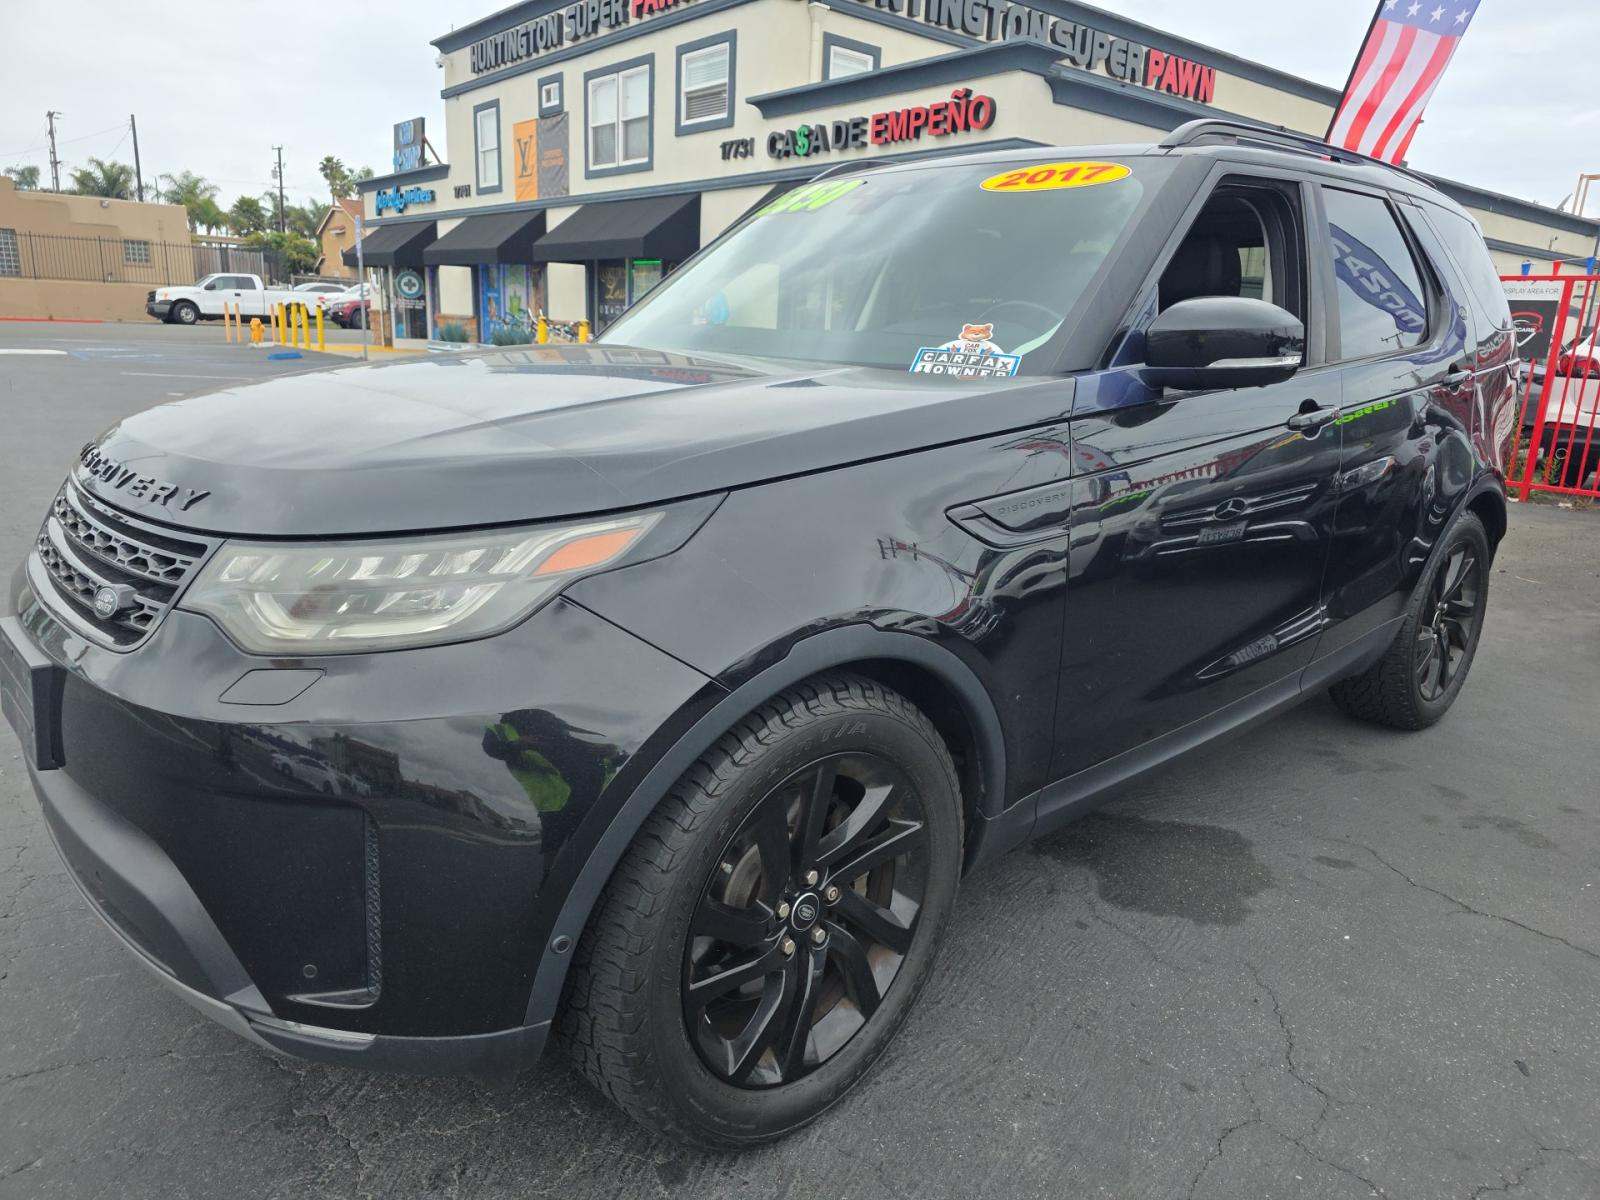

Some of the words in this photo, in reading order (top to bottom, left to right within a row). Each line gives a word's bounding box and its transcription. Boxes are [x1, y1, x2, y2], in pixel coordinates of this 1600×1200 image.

[470, 13, 563, 73] HUNTINGTON
[564, 0, 629, 41] SUPER
[1050, 20, 1144, 83] SUPER
[1142, 48, 1216, 103] PAWN
[831, 117, 868, 150] DE
[870, 88, 996, 145] EMPEÑO
[719, 137, 755, 160] 17731
[1003, 165, 1113, 187] 2017
[923, 352, 1012, 370] CARFAX
